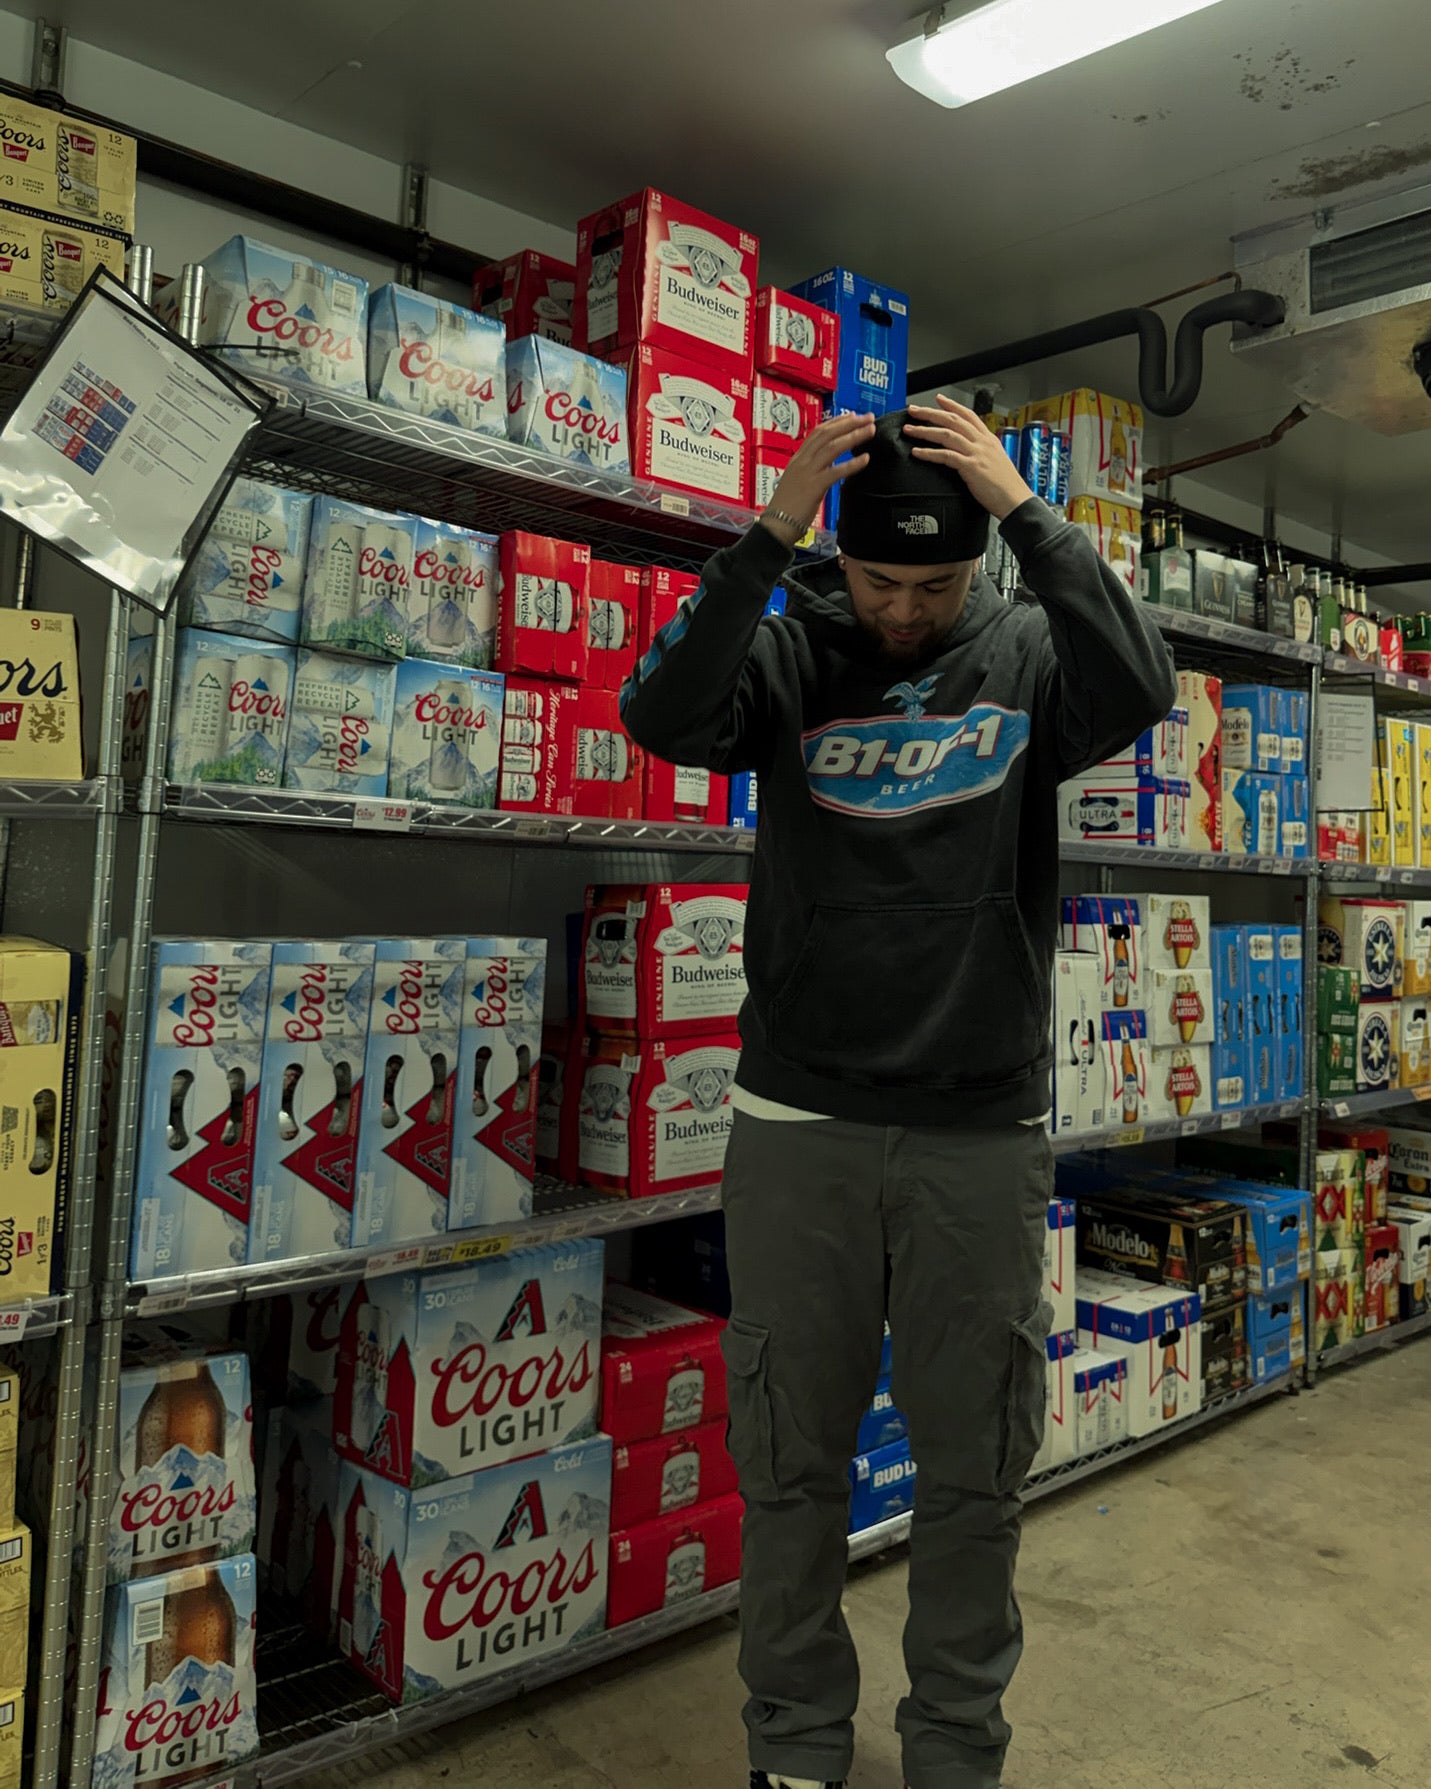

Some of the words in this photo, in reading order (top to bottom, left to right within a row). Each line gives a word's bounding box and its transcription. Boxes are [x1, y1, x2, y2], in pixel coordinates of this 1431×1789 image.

[109, 134, 122, 145] 12
[58, 127, 71, 192] Coors
[651, 192, 661, 202] 12
[0, 242, 30, 260] ors
[95, 239, 109, 249] 12
[43, 235, 57, 302] Coors
[843, 271, 853, 281] 12
[667, 276, 741, 321] Budweiser
[247, 295, 354, 361] Coors
[399, 338, 495, 402] Coors
[863, 355, 887, 374] BUD
[859, 367, 889, 390] LIGHT
[409, 381, 485, 421] LIGHT
[545, 388, 621, 444] Coors
[552, 423, 613, 461] LIGHT
[660, 429, 735, 466] Budweiser
[1038, 442, 1049, 487] ULTRA
[1058, 451, 1069, 496] ULTRA
[329, 506, 340, 517] 12
[228, 543, 247, 599] LIGHT
[414, 550, 485, 588] Coors
[656, 571, 669, 581] 12
[361, 578, 409, 604] LIGHT
[420, 579, 477, 603] LIGHT
[521, 575, 532, 626] udweise
[31, 618, 40, 630] 9
[196, 640, 209, 651] 12
[0, 658, 67, 697] ors
[415, 692, 487, 729] Coors
[230, 714, 283, 736] LIGHT
[422, 725, 478, 745] LIGHT
[319, 715, 337, 767] LIGHT
[578, 731, 588, 779] udweise
[676, 768, 708, 783] udweise
[880, 773, 937, 795] BEER
[1079, 810, 1117, 820] ULTRA
[660, 888, 671, 898] 12
[1170, 923, 1194, 933] STELLA
[1170, 933, 1194, 943] ARTOIS
[586, 970, 633, 987] Budweiser
[672, 964, 745, 984] Budweise
[422, 962, 442, 1030] LIGHT
[507, 958, 525, 1023] LIGHT
[217, 967, 242, 1041] LIGHT
[325, 966, 348, 1036] LIGHT
[1175, 998, 1198, 1008] STELLA
[1175, 1007, 1198, 1017] ARTOIS
[654, 1042, 665, 1052] 12
[1171, 1072, 1195, 1082] STELLA
[1171, 1082, 1195, 1091] ARTOIS
[665, 1117, 733, 1141] Budweis
[1389, 1143, 1431, 1163] Coron
[463, 1200, 476, 1219] 18
[371, 1217, 384, 1235] 18
[268, 1232, 281, 1251] 18
[1092, 1221, 1149, 1258] Modelo
[155, 1247, 171, 1267] 18
[553, 1255, 581, 1273] Cold
[424, 1294, 446, 1310] 30
[0, 1313, 20, 1326] .49
[224, 1360, 241, 1374] 12
[619, 1362, 632, 1374] 24
[430, 1340, 594, 1427] Coors
[873, 1392, 892, 1411] BU
[459, 1401, 566, 1458] LIGHT
[553, 1452, 585, 1473] Cold
[856, 1458, 869, 1470] 24
[873, 1465, 904, 1489] BUD
[121, 1480, 237, 1532] Coors
[415, 1503, 440, 1522] 30
[132, 1515, 224, 1557] LIGHT
[618, 1541, 631, 1553] 24
[0, 1564, 24, 1577] OTTLES
[233, 1562, 251, 1579] 12
[423, 1538, 599, 1642] Coors
[456, 1602, 569, 1671] LIGHT
[124, 1691, 241, 1751] Coors
[135, 1728, 229, 1776] LIGHT
